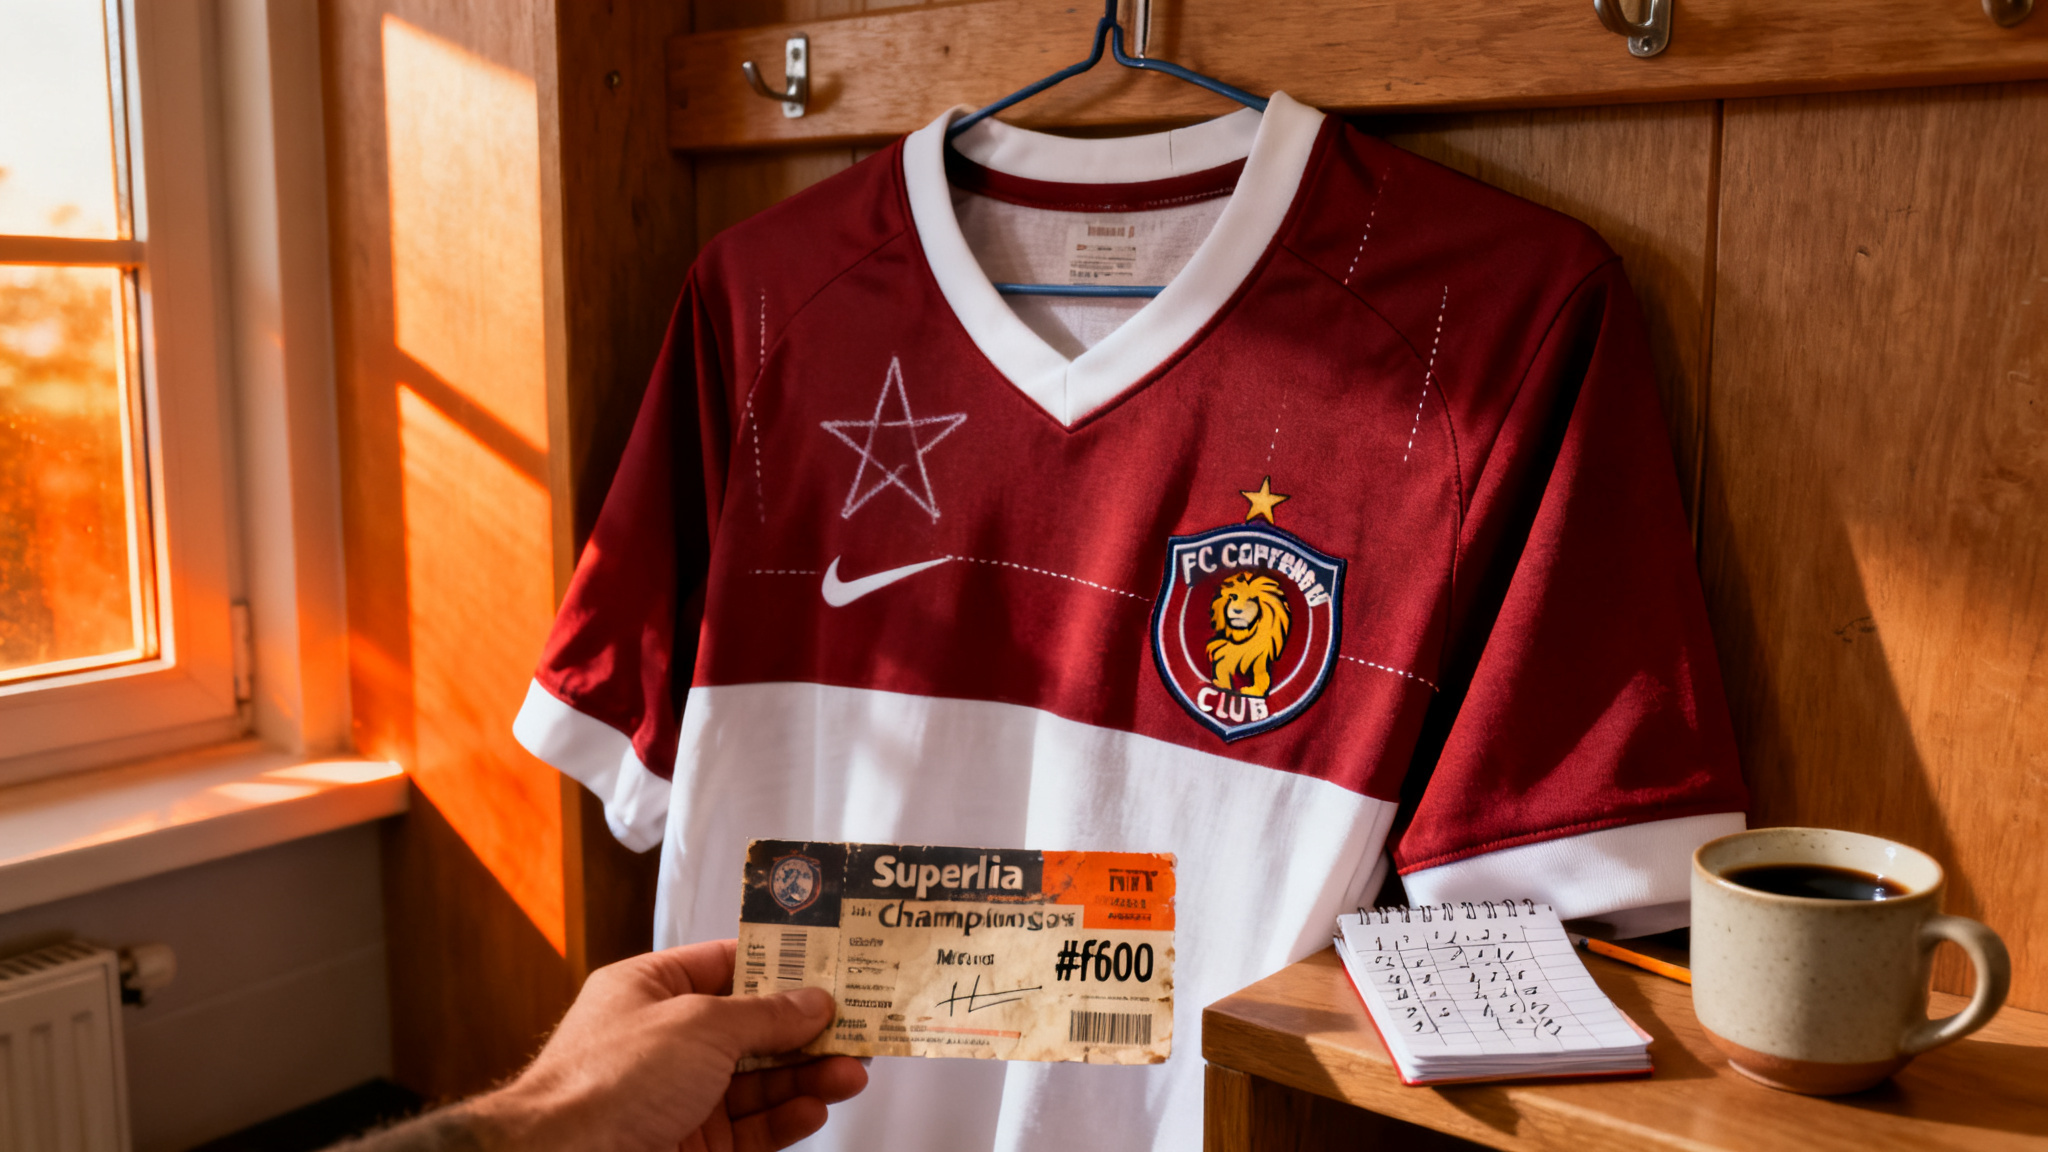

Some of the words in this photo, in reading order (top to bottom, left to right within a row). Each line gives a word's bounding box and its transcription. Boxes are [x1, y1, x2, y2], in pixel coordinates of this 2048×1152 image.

[1182, 546, 1217, 584] FC
[1197, 687, 1269, 722] CLUB
[872, 855, 1024, 898] Superlia
